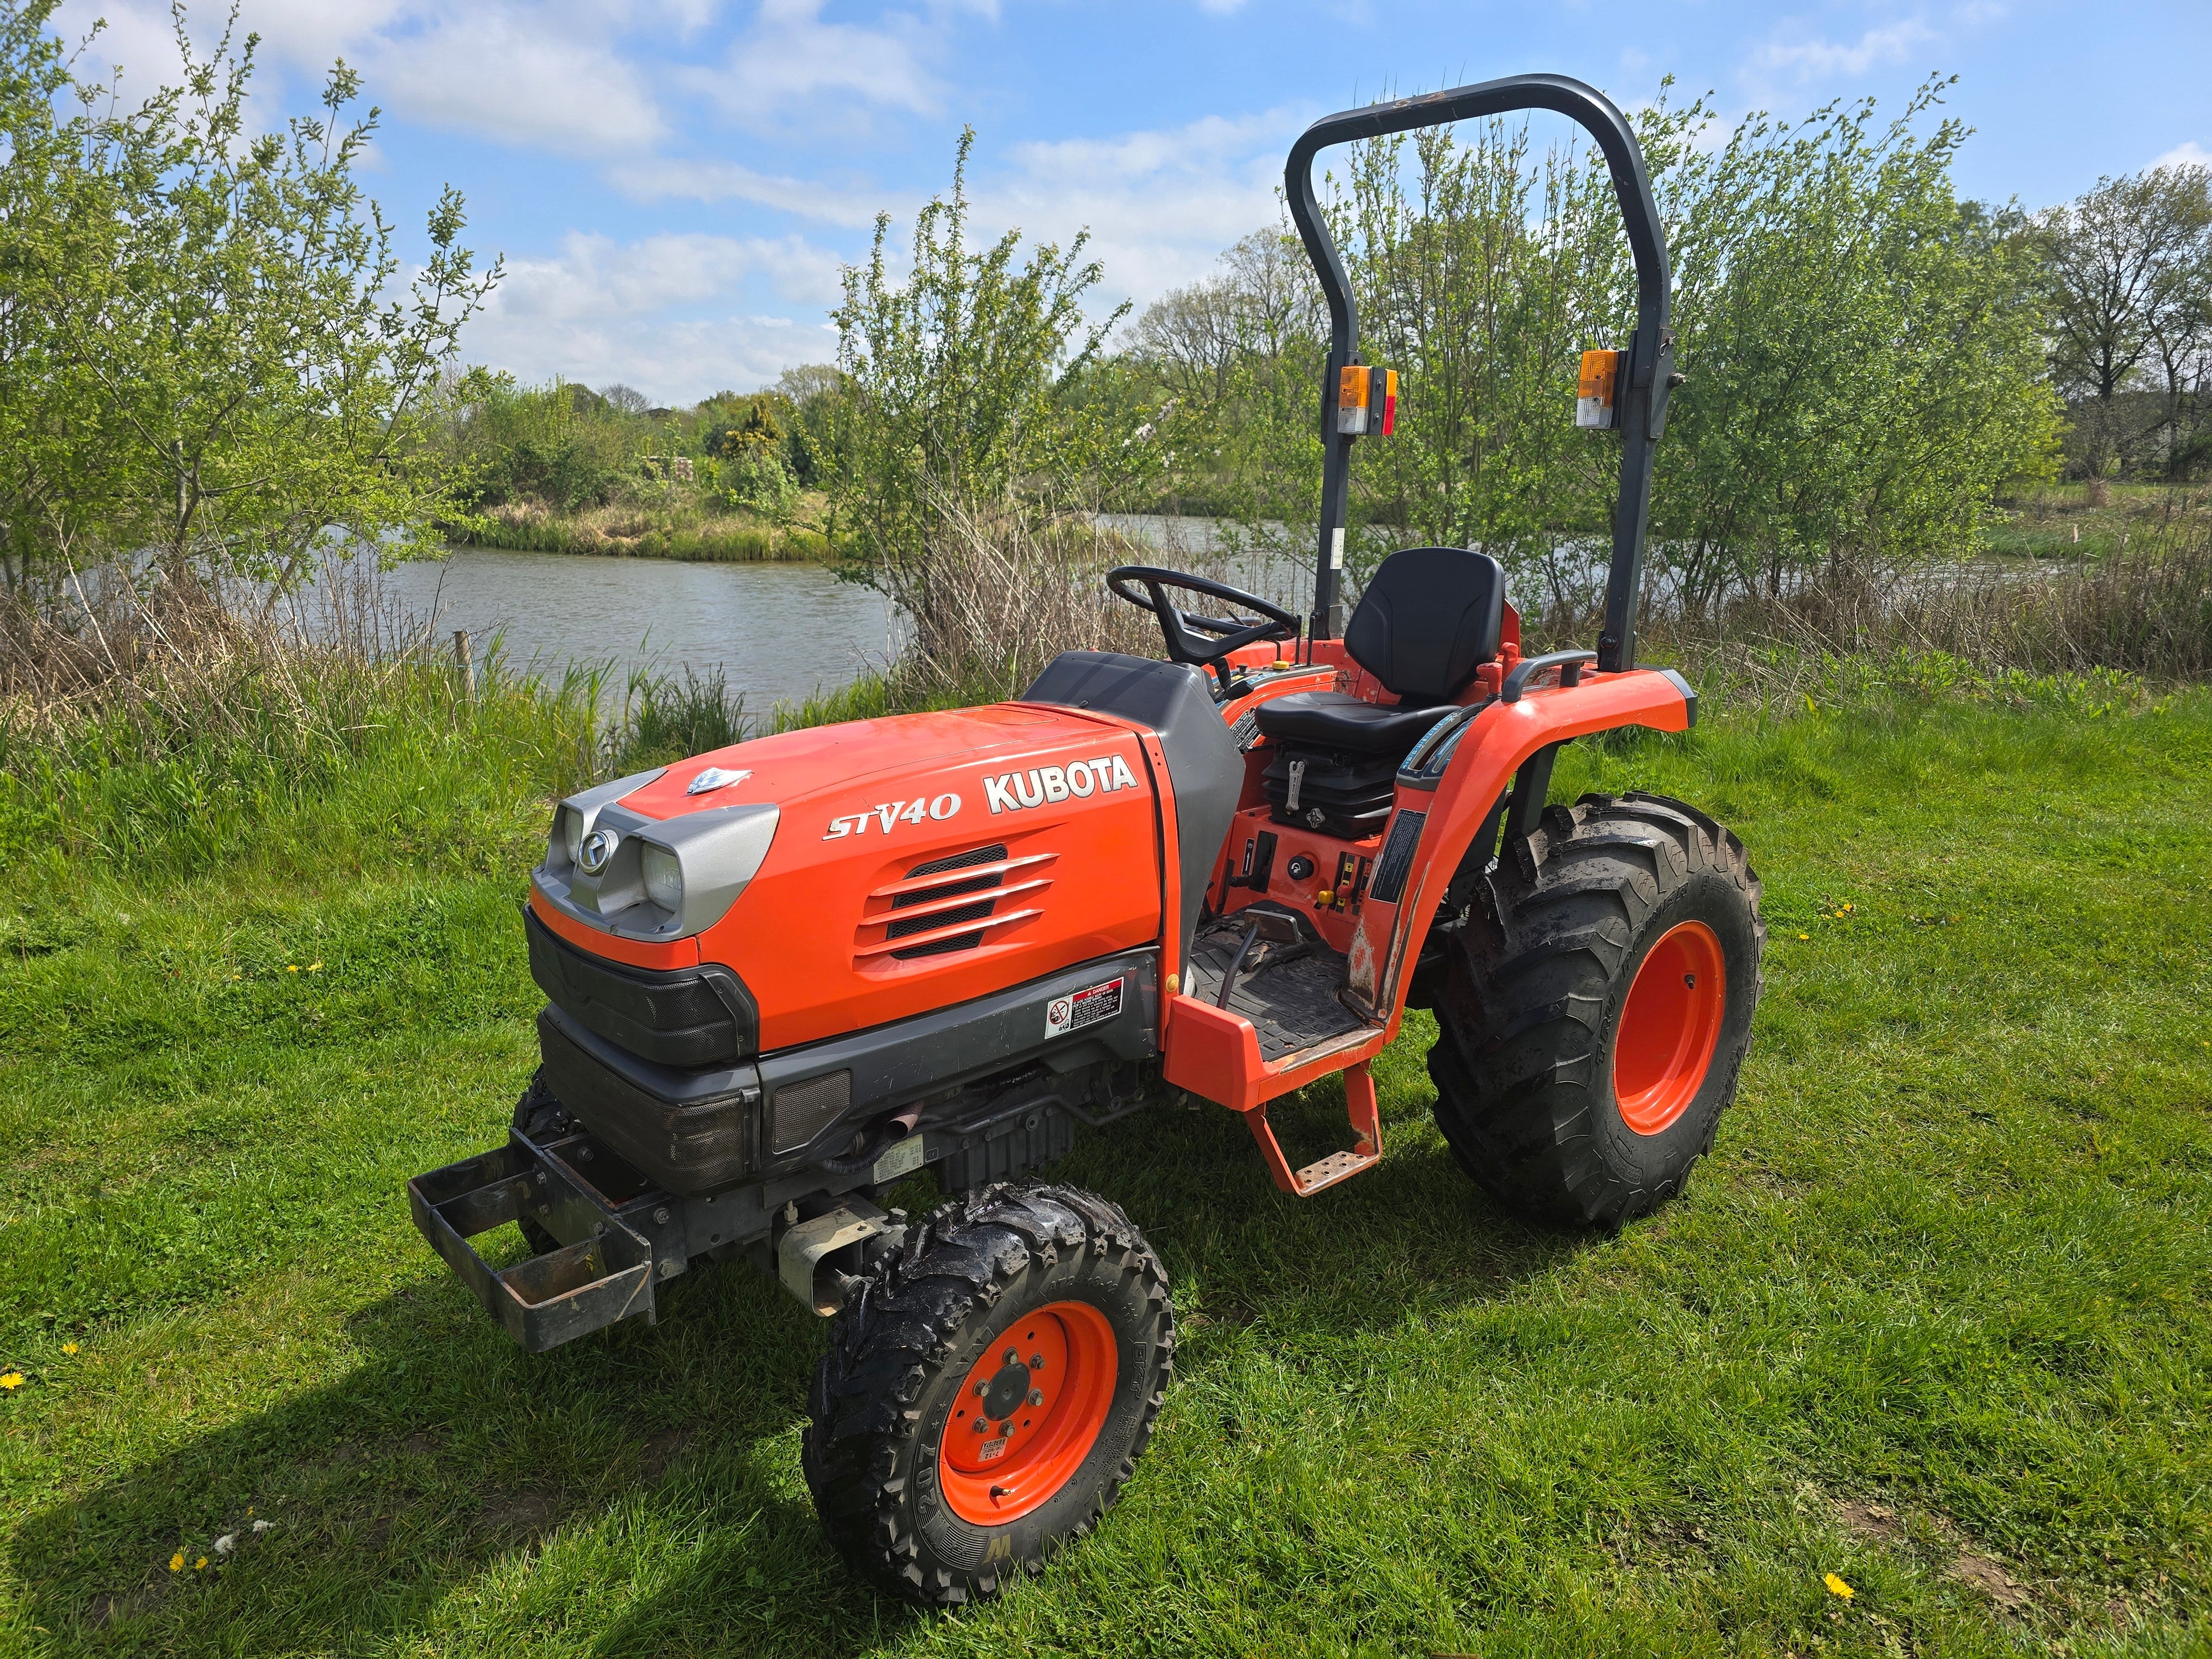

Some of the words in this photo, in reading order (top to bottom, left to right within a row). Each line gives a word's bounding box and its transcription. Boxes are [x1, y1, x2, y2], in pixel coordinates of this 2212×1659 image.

[983, 755, 1138, 814] KUBOTA
[822, 793, 961, 841] STV40
[1092, 984, 1109, 994] DANGER
[985, 1451, 999, 1459] 7-12
[981, 1533, 1011, 1566] W
